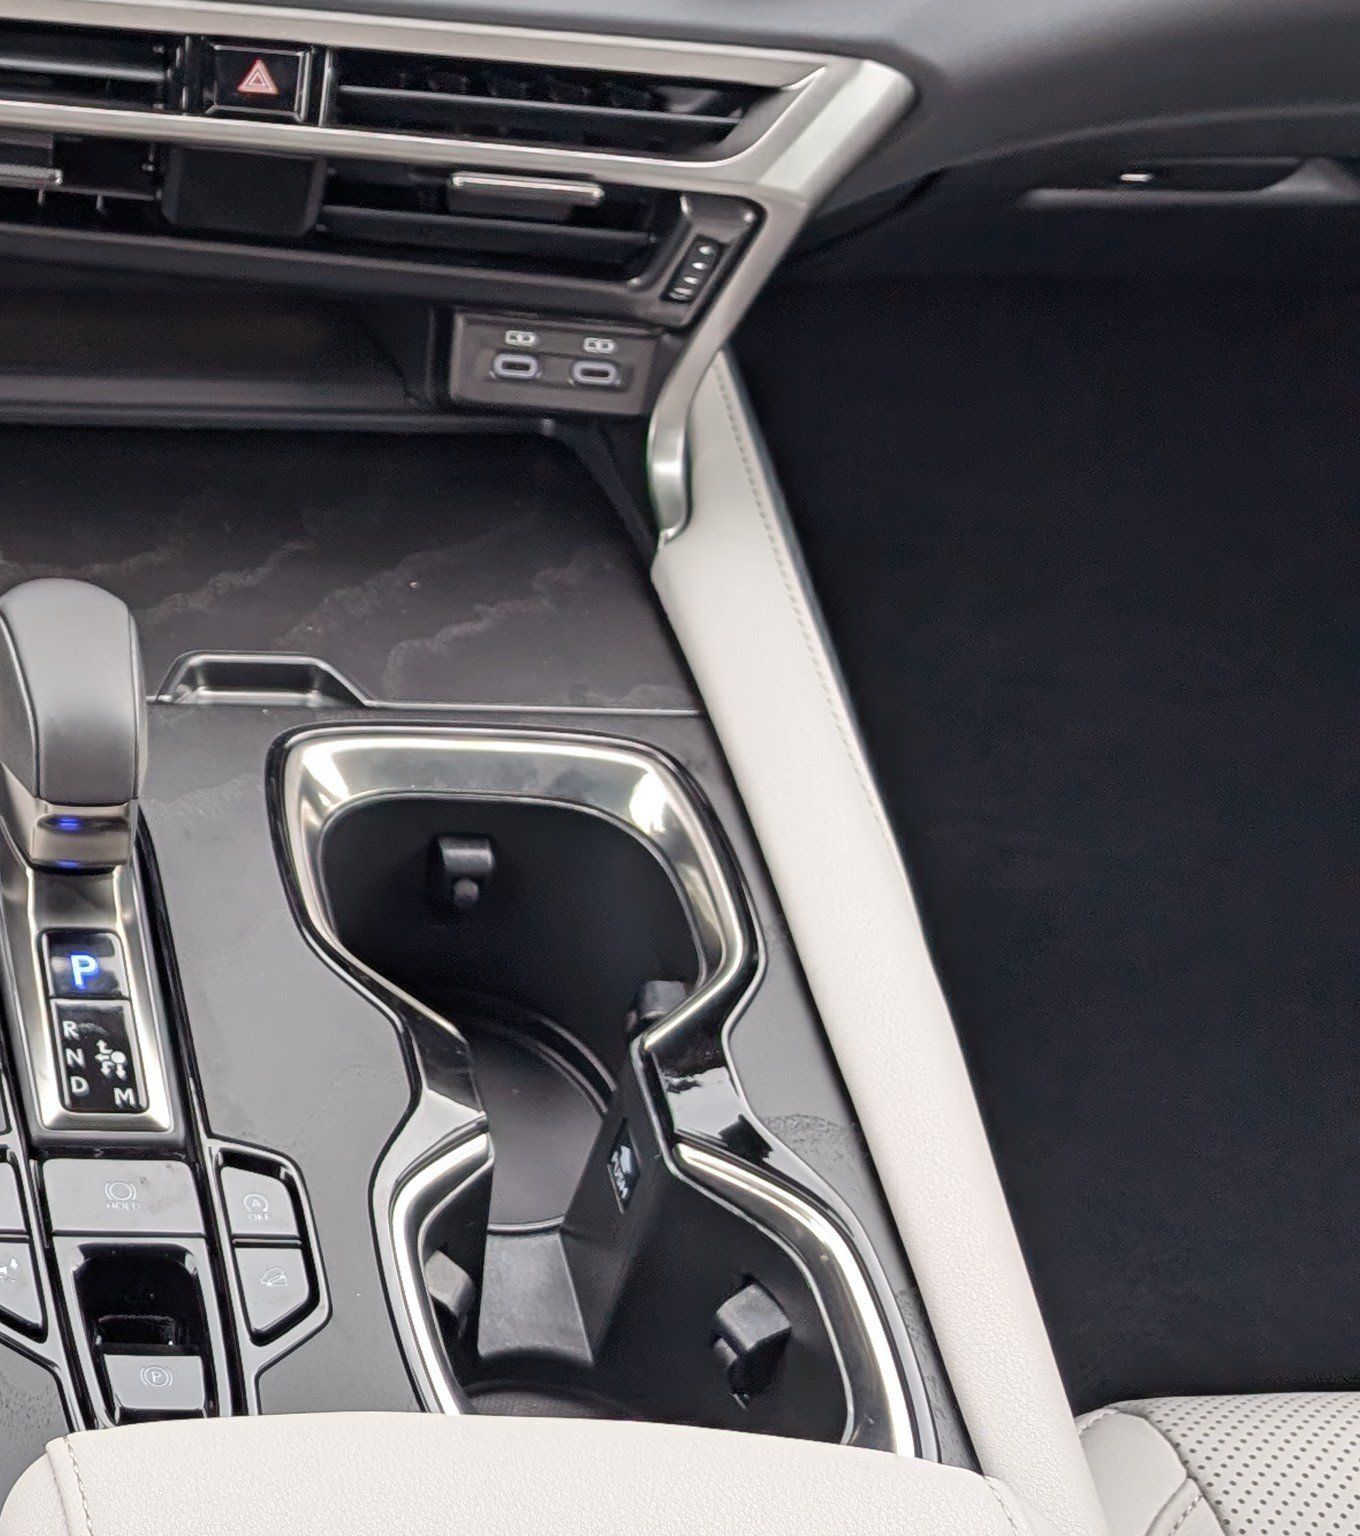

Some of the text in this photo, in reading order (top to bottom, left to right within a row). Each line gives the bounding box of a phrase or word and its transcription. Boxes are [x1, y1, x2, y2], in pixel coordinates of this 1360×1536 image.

[70, 953, 98, 990] P
[62, 1020, 80, 1040] R
[65, 1048, 86, 1069] N
[70, 1076, 90, 1097] D
[113, 1087, 137, 1109] M
[105, 1201, 140, 1211] HOLD
[248, 1212, 271, 1222] OFF
